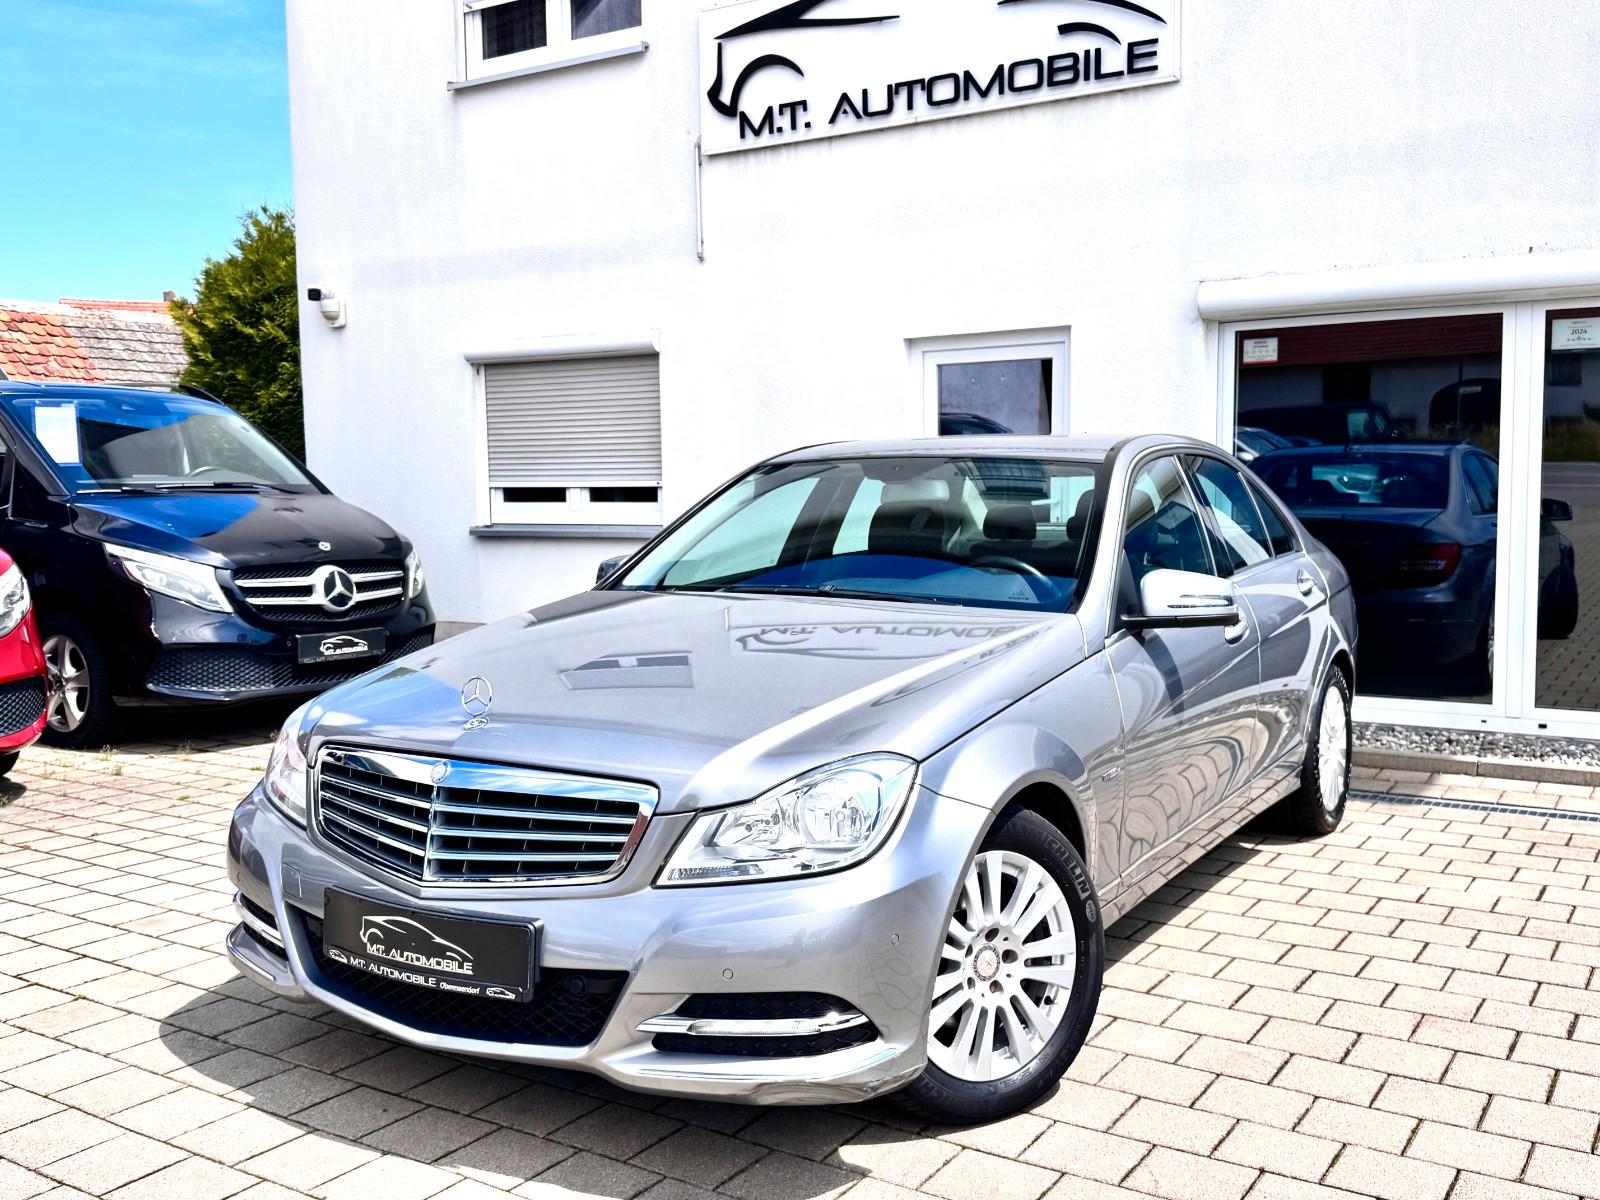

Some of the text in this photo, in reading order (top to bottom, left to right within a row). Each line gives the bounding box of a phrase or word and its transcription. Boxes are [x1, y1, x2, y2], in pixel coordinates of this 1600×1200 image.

[739, 38, 1159, 139] M.T. AUTOMOBILE
[350, 956, 366, 969] M.T.
[368, 963, 437, 987] AUTOMOBILE
[367, 942, 473, 972] M.T. AUTOMOBILE
